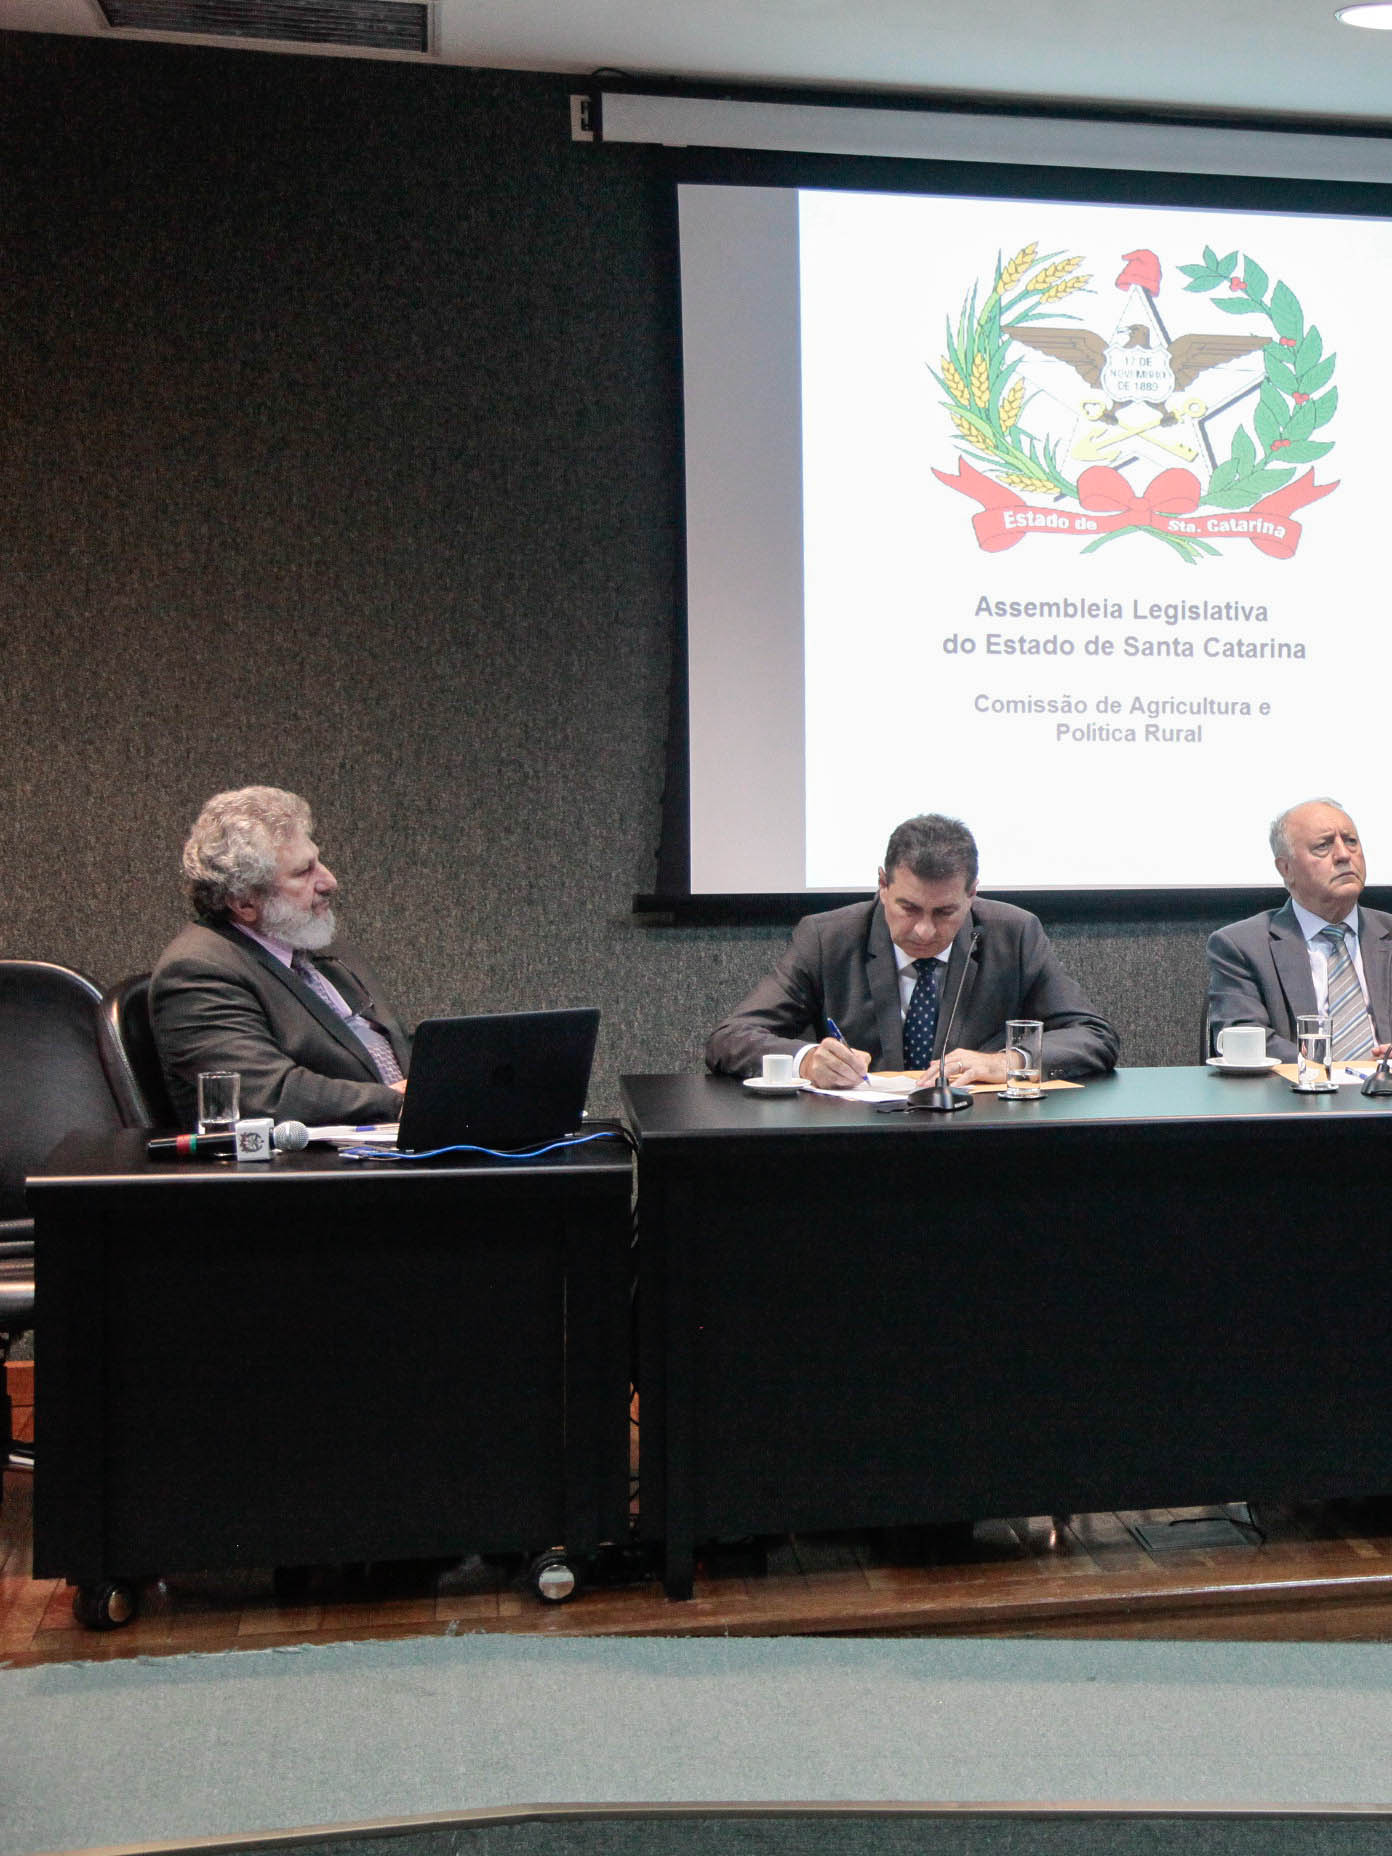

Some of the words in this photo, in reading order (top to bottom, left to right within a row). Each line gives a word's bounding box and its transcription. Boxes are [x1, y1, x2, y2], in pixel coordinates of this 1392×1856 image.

[1003, 509, 1070, 530] Estado
[1074, 516, 1098, 531] de
[1167, 519, 1202, 534] Sta.
[1206, 518, 1287, 540] Catarina
[975, 595, 1123, 619] Assembleia
[1133, 599, 1268, 626] Legislativa
[943, 633, 977, 655] do
[984, 633, 1075, 656] Estado
[1084, 635, 1116, 656] de
[1124, 636, 1194, 658] Santa
[1203, 637, 1307, 660] Catarina
[974, 694, 1088, 714] Comissão
[1096, 696, 1122, 714] de
[1129, 696, 1252, 719] Agricultura
[1258, 702, 1272, 716] e
[1145, 724, 1203, 743] Rural
